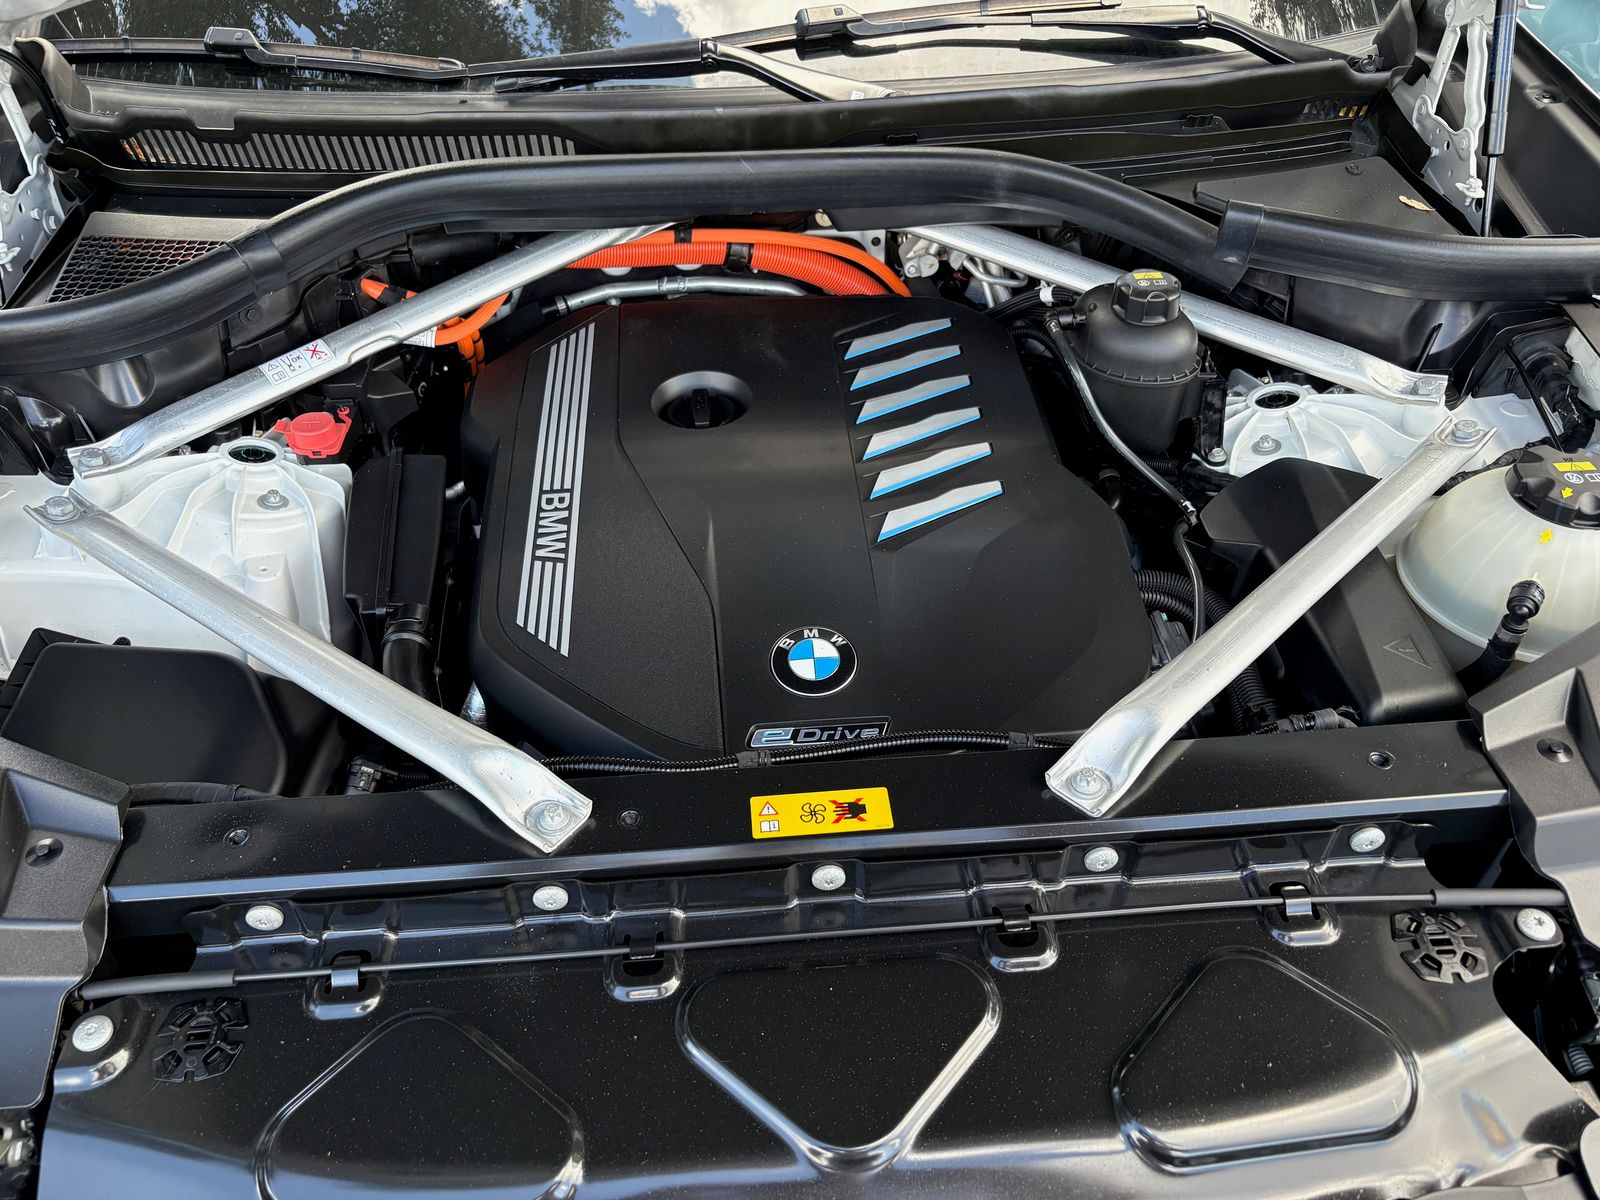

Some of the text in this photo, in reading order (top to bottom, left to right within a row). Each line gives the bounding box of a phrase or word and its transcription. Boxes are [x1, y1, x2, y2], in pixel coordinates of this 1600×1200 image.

[291, 354, 303, 363] OK
[535, 492, 571, 559] BMW
[778, 628, 848, 651] BMW
